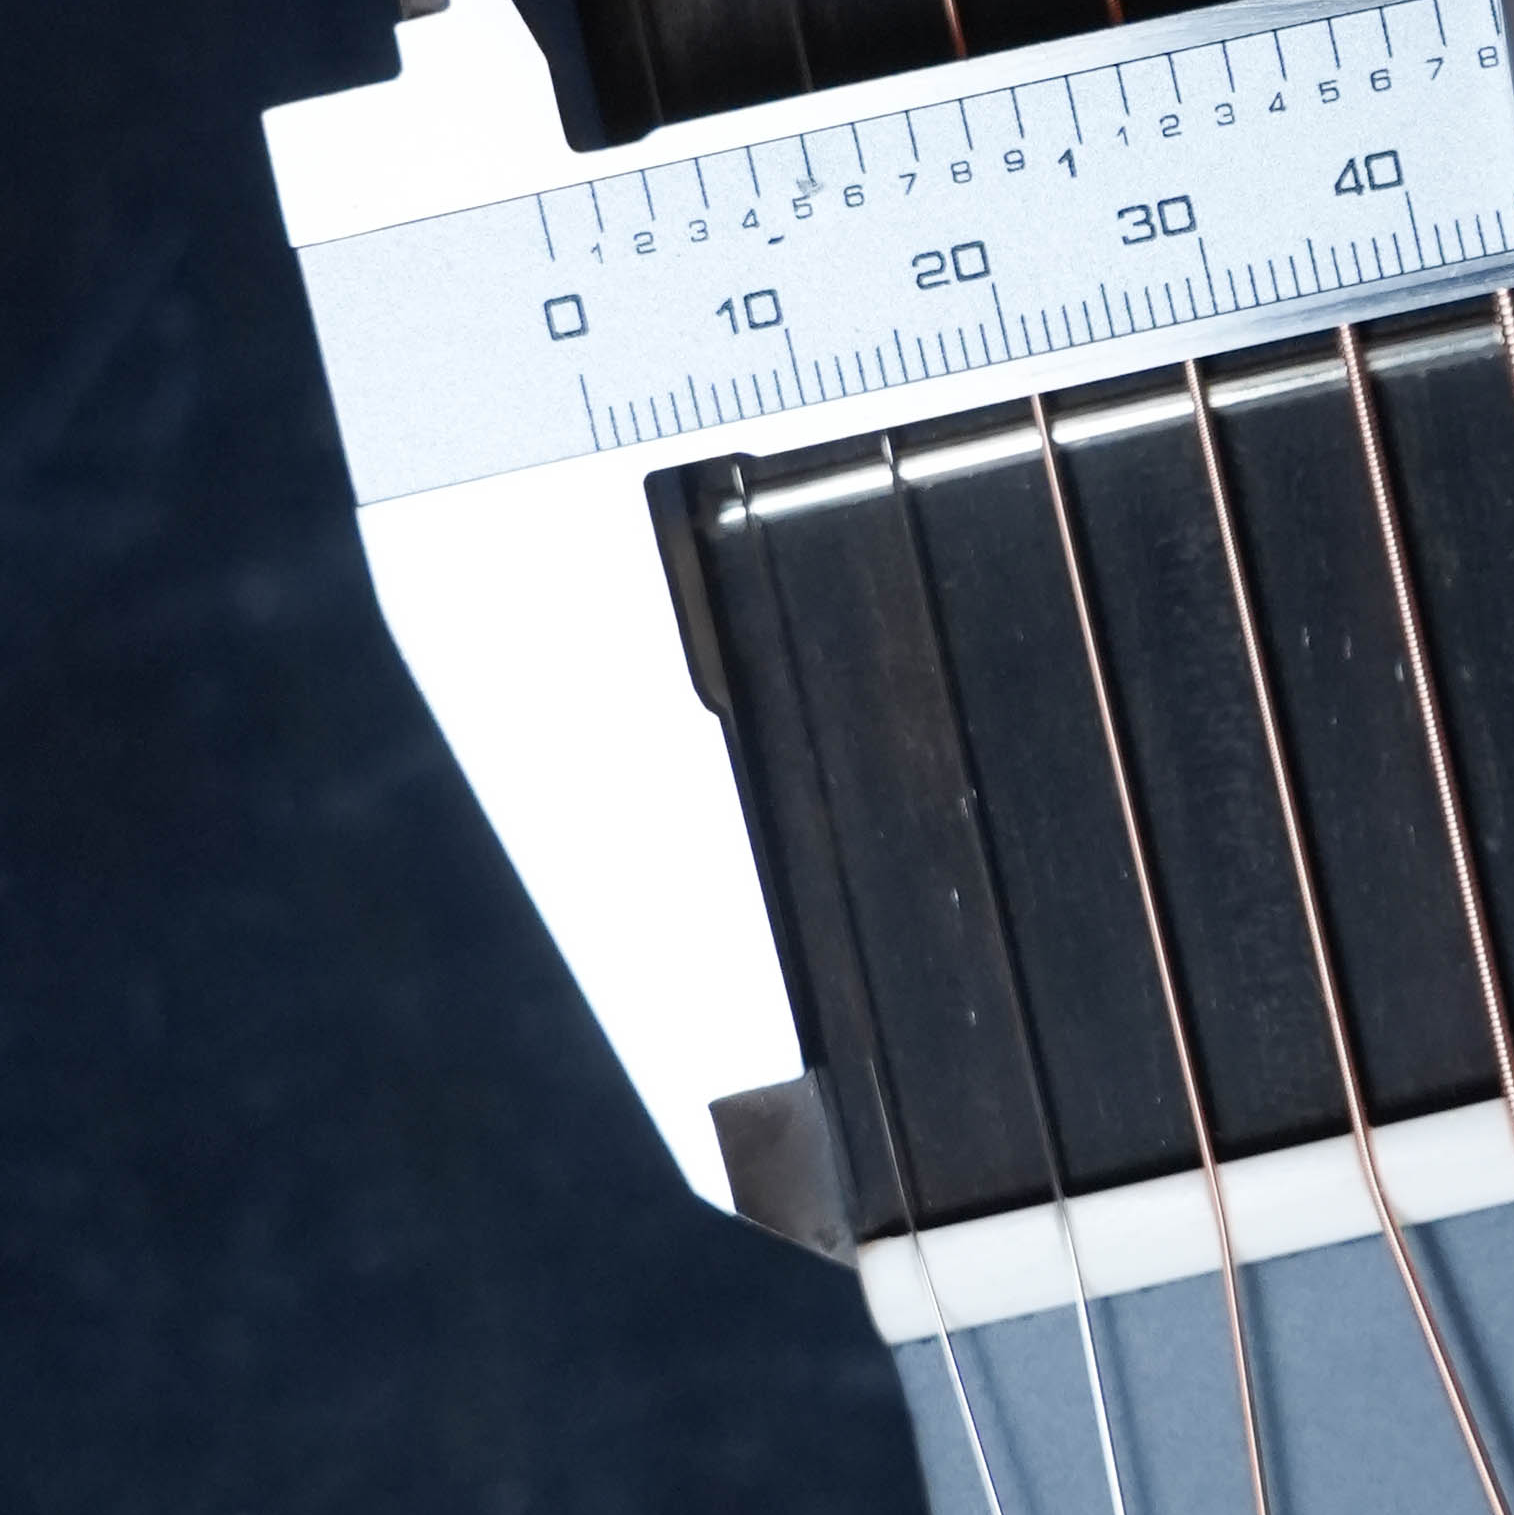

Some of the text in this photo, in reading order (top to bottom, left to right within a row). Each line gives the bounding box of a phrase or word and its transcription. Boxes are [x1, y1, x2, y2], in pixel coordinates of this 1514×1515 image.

[542, 149, 1404, 342] 0 10 20 30 40
[591, 45, 1500, 264] 1 2 3 4 5 6 7 8 9 1 1 2 3 4 5 6 7 8
